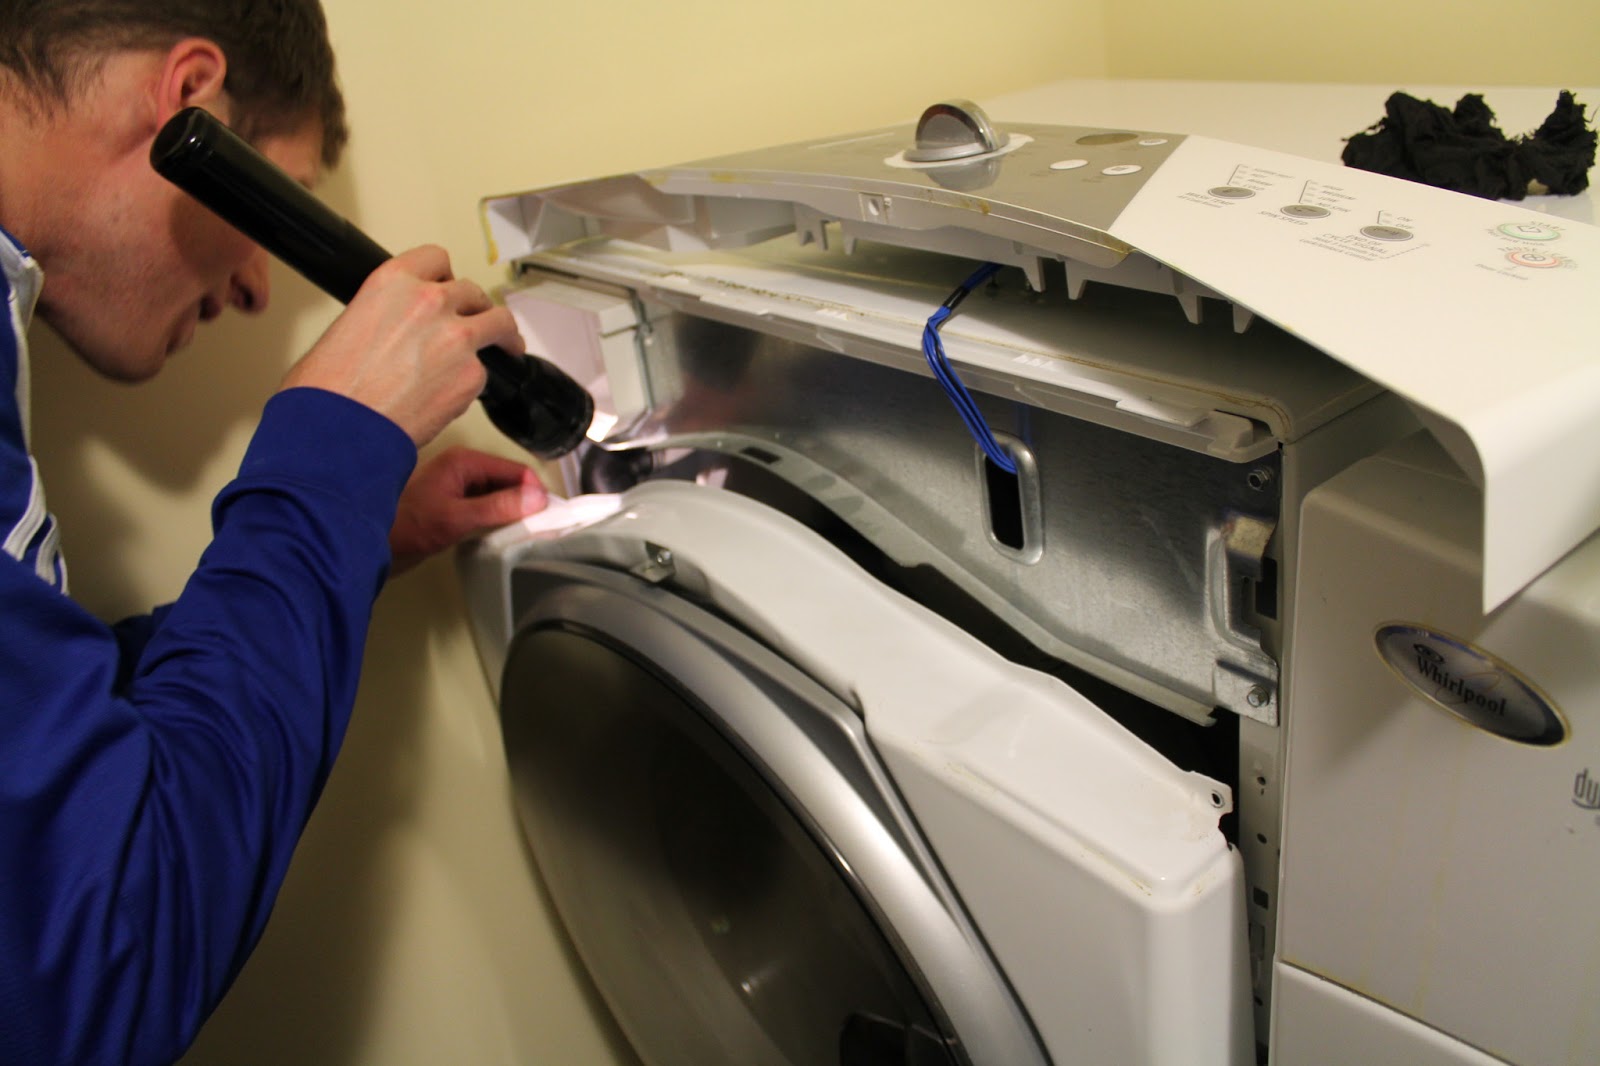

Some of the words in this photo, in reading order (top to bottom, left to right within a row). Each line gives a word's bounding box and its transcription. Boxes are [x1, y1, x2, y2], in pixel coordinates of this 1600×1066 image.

[1186, 192, 1211, 200] WASH
[1322, 190, 1356, 200] MEDIUM
[1259, 210, 1279, 218] SPIN
[1281, 216, 1308, 225] SPEED
[1322, 233, 1351, 244] CYCLE
[1352, 241, 1388, 254] SIGNAL
[1346, 234, 1367, 243] END
[1367, 239, 1383, 247] OF
[1416, 655, 1508, 716] Whirlpool
[1574, 767, 1600, 805] du
